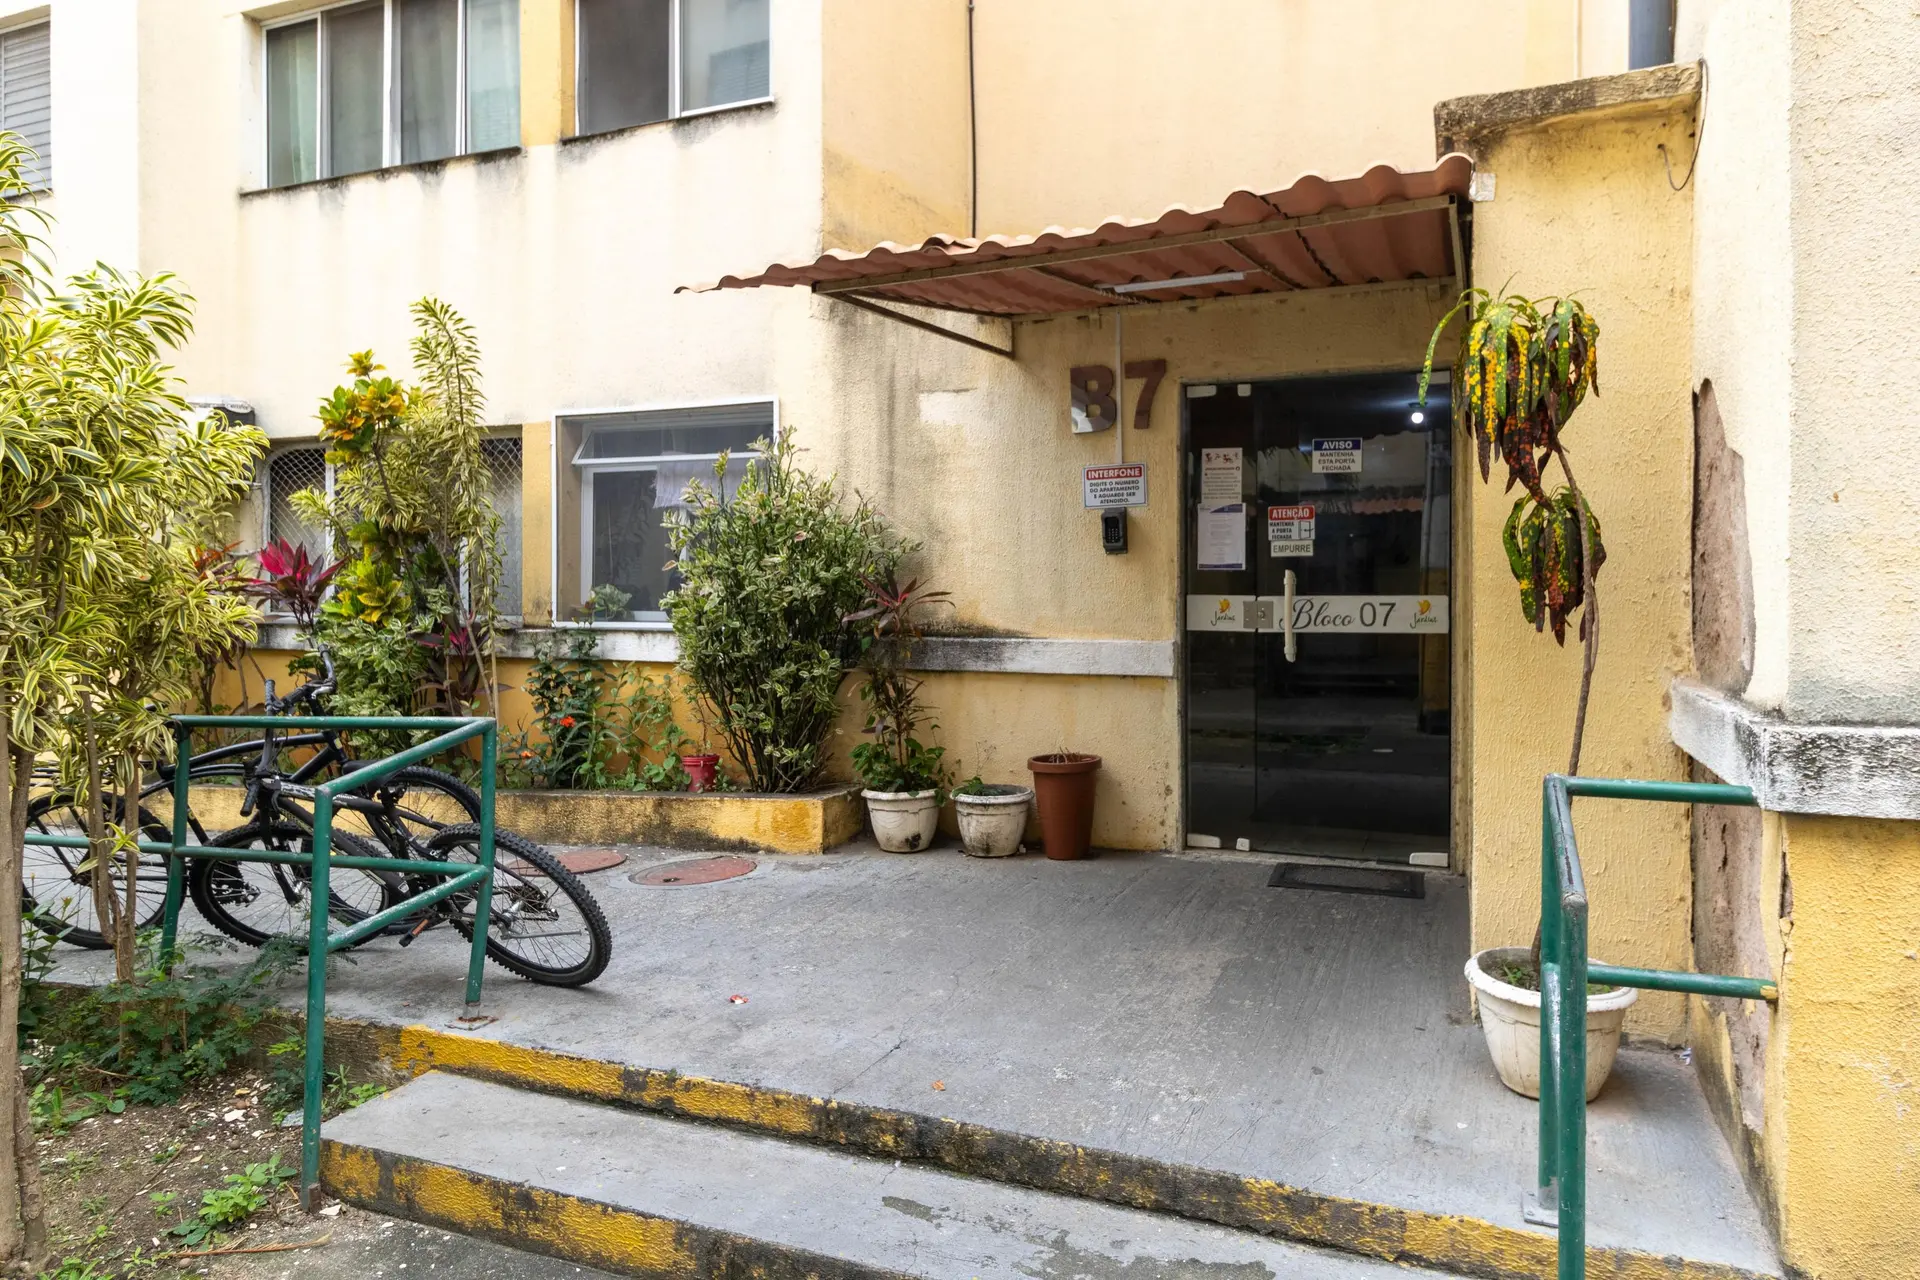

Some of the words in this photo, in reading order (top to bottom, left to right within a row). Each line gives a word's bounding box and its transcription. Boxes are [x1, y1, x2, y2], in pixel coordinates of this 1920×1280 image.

[1322, 441, 1353, 450] AVISO
[1088, 468, 1140, 479] INTERFONE
[1273, 544, 1311, 553] EMPURRE
[1279, 597, 1355, 630] Bloco
[1360, 602, 1396, 627] 07
